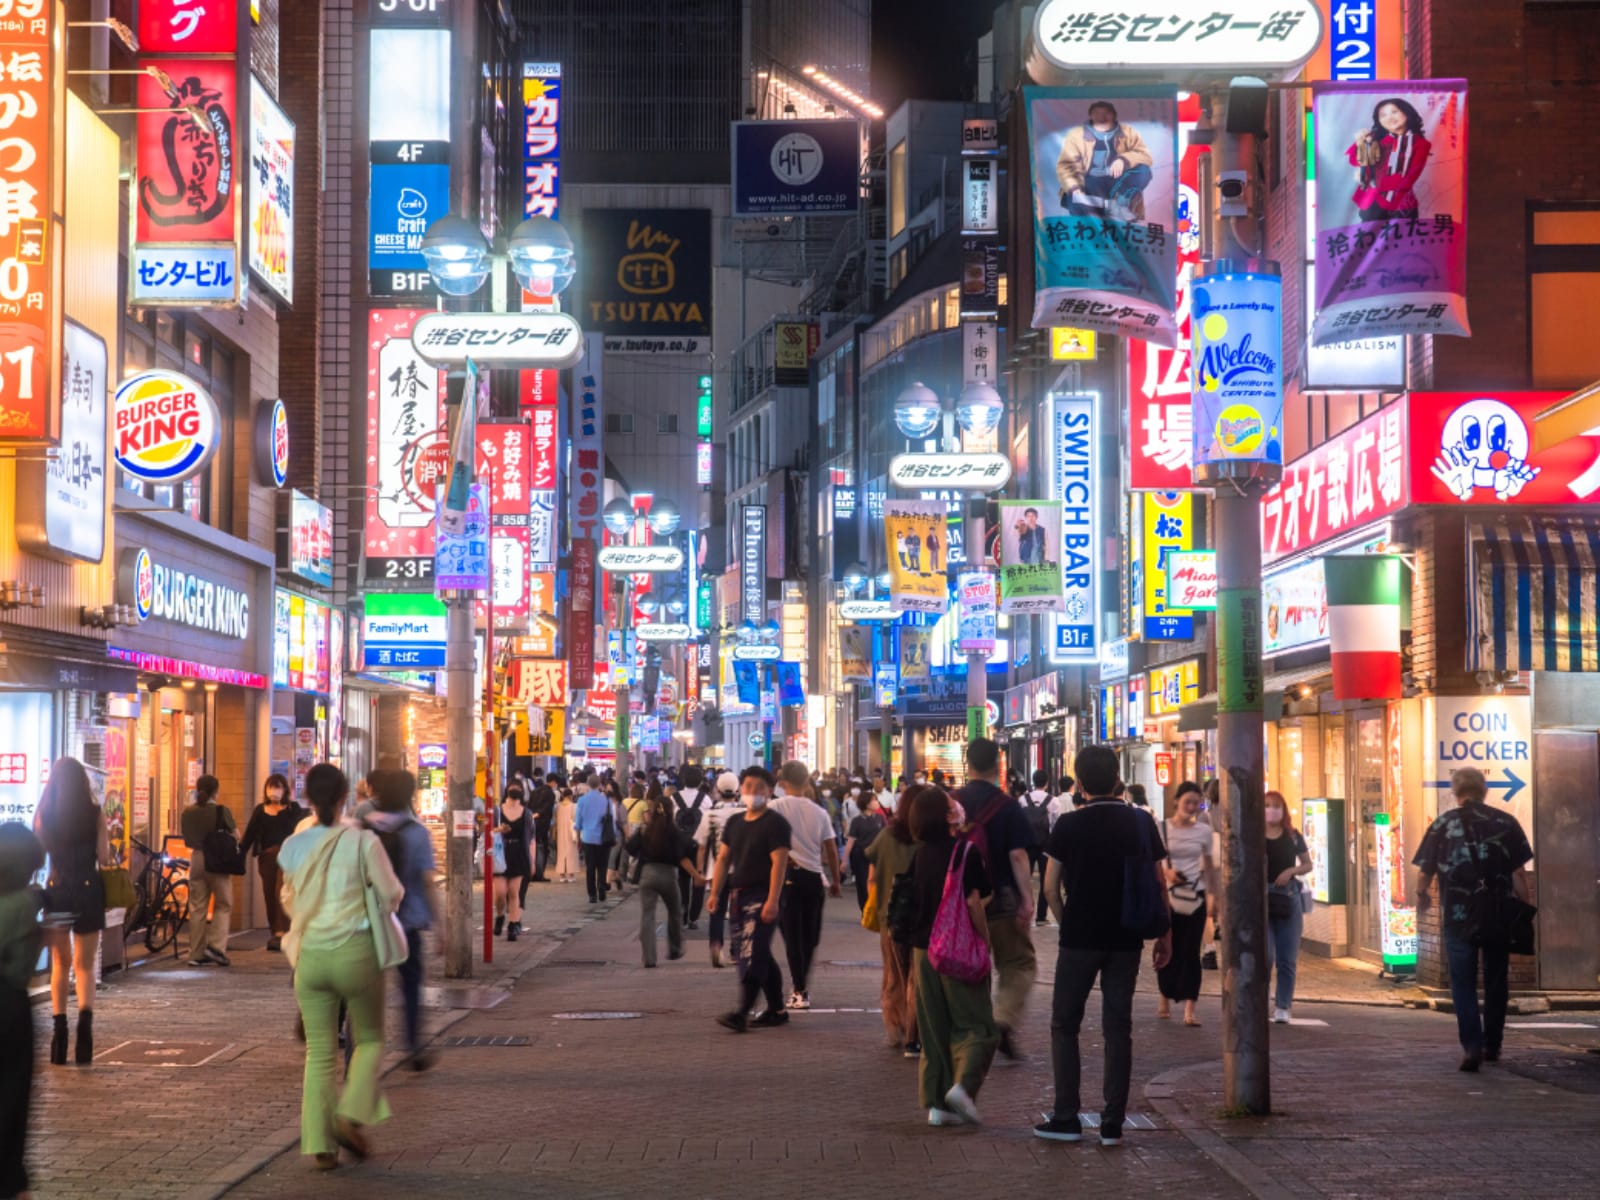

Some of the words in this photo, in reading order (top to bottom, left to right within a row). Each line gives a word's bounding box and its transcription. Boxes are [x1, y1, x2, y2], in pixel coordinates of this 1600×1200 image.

[30, 18, 46, 36] 円
[1050, 11, 1306, 43] 渋谷センター街
[397, 143, 424, 162] 4F
[1046, 220, 1166, 247] 拾われた男
[1326, 213, 1454, 259] 拾われた男
[138, 260, 233, 288] センタービル
[391, 272, 431, 291] B1F
[27, 291, 44, 310] 円
[591, 302, 704, 322] TSUTAYA
[1056, 298, 1141, 327] 渋谷センター街
[1332, 303, 1448, 328] 渋谷センター街
[421, 327, 573, 347] 渋谷センター街
[1199, 333, 1277, 388] Welcome
[116, 392, 197, 430] BURGER
[119, 410, 201, 457] KING
[897, 462, 1004, 479] 渋谷センター街
[1064, 412, 1090, 526] SWITCH
[1064, 533, 1091, 589] BAR
[153, 564, 214, 631] BURGER
[215, 585, 250, 640] KING
[368, 622, 429, 636] FamilyMart
[1062, 627, 1089, 646] B1F
[378, 650, 392, 664] 酒
[395, 651, 420, 663] たばこ
[518, 660, 563, 704] 豚
[1453, 712, 1508, 732] COIN
[1439, 740, 1529, 761] LOCKER
